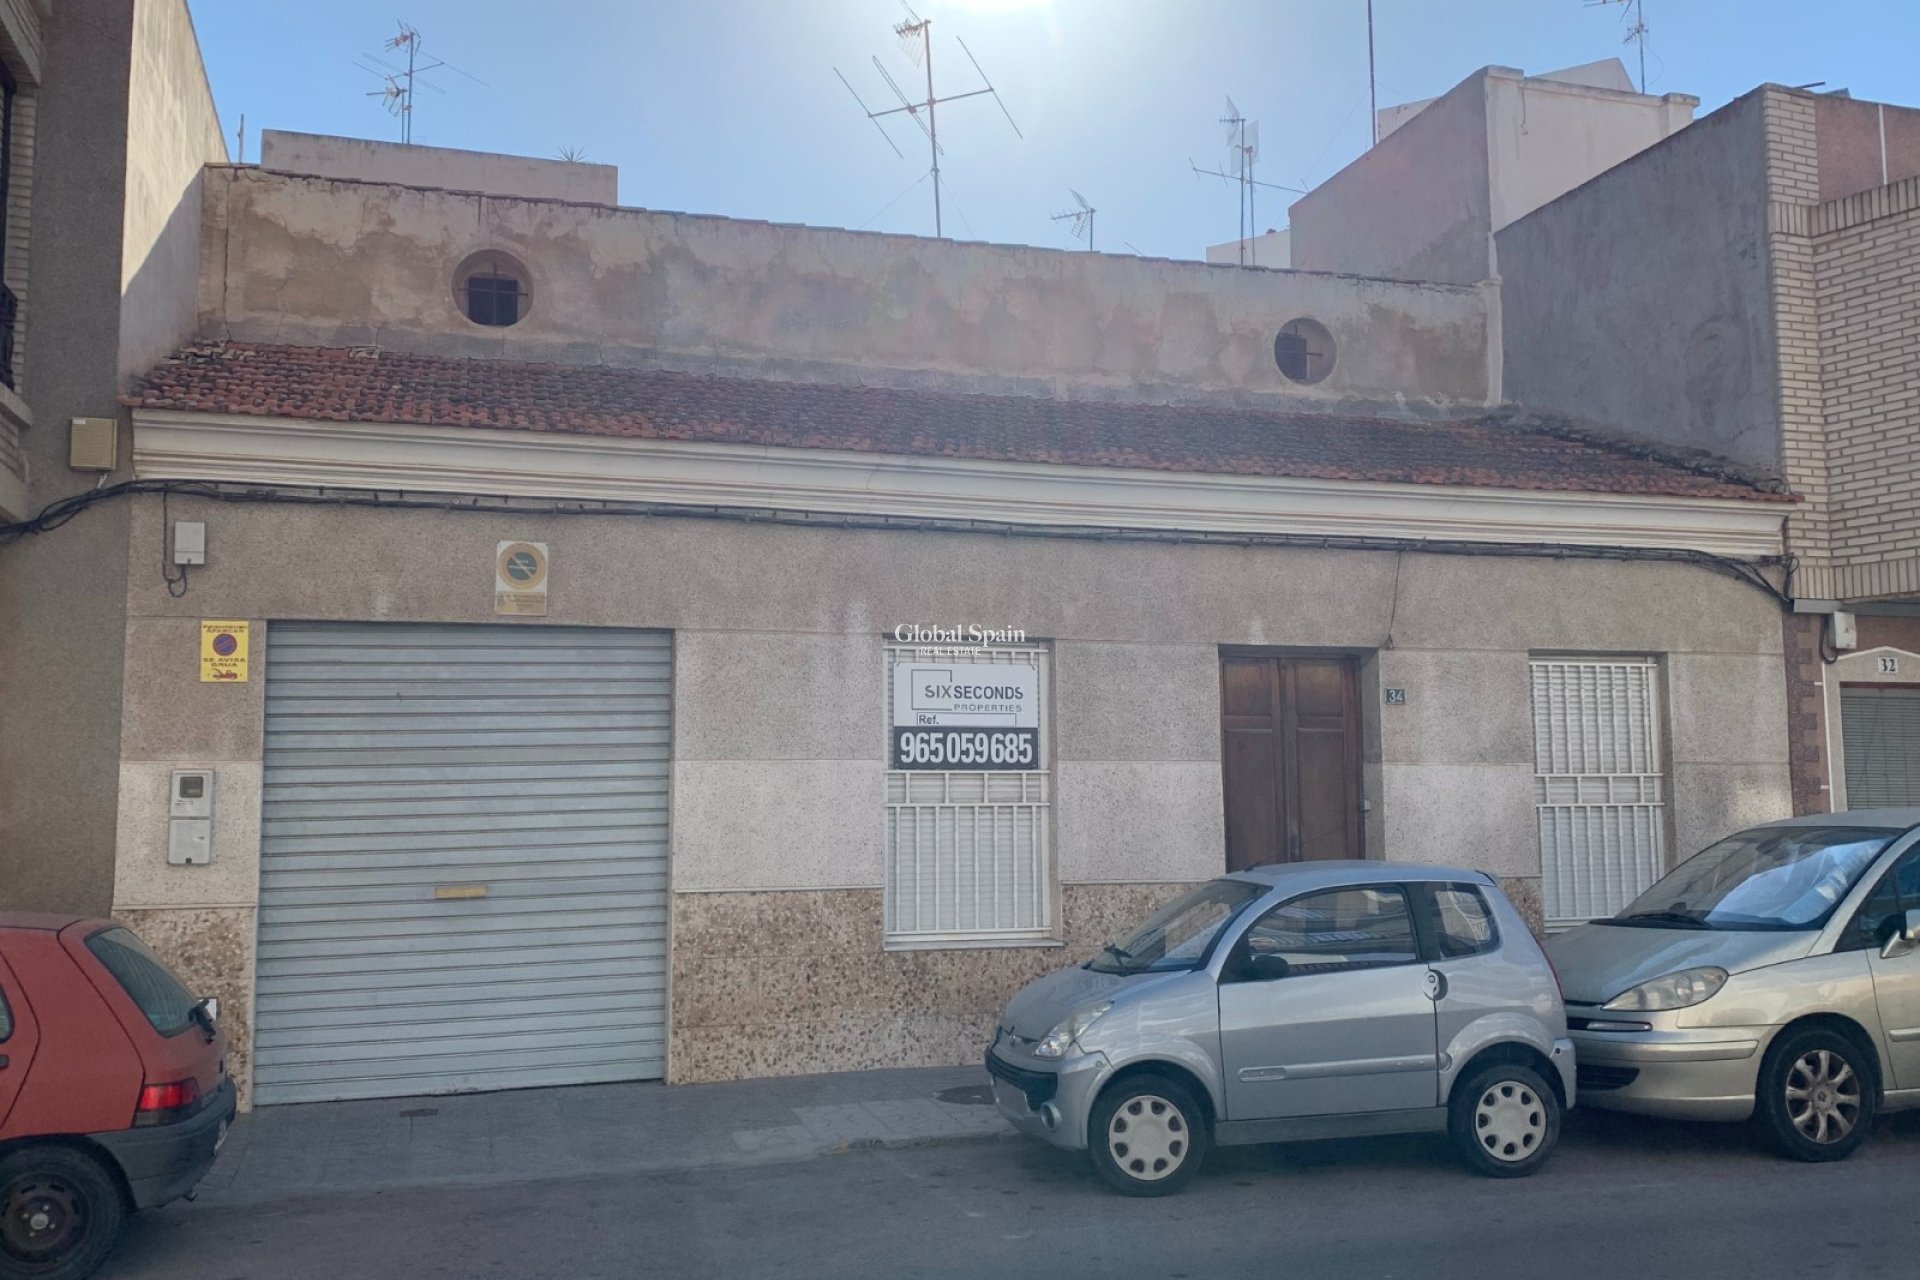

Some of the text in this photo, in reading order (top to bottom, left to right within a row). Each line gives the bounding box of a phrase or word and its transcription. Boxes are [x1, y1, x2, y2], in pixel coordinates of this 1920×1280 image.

[1881, 658, 1896, 672] 32
[1388, 690, 1403, 702] 34
[954, 704, 1022, 712] PROPERTIES
[919, 715, 939, 725] Ref.
